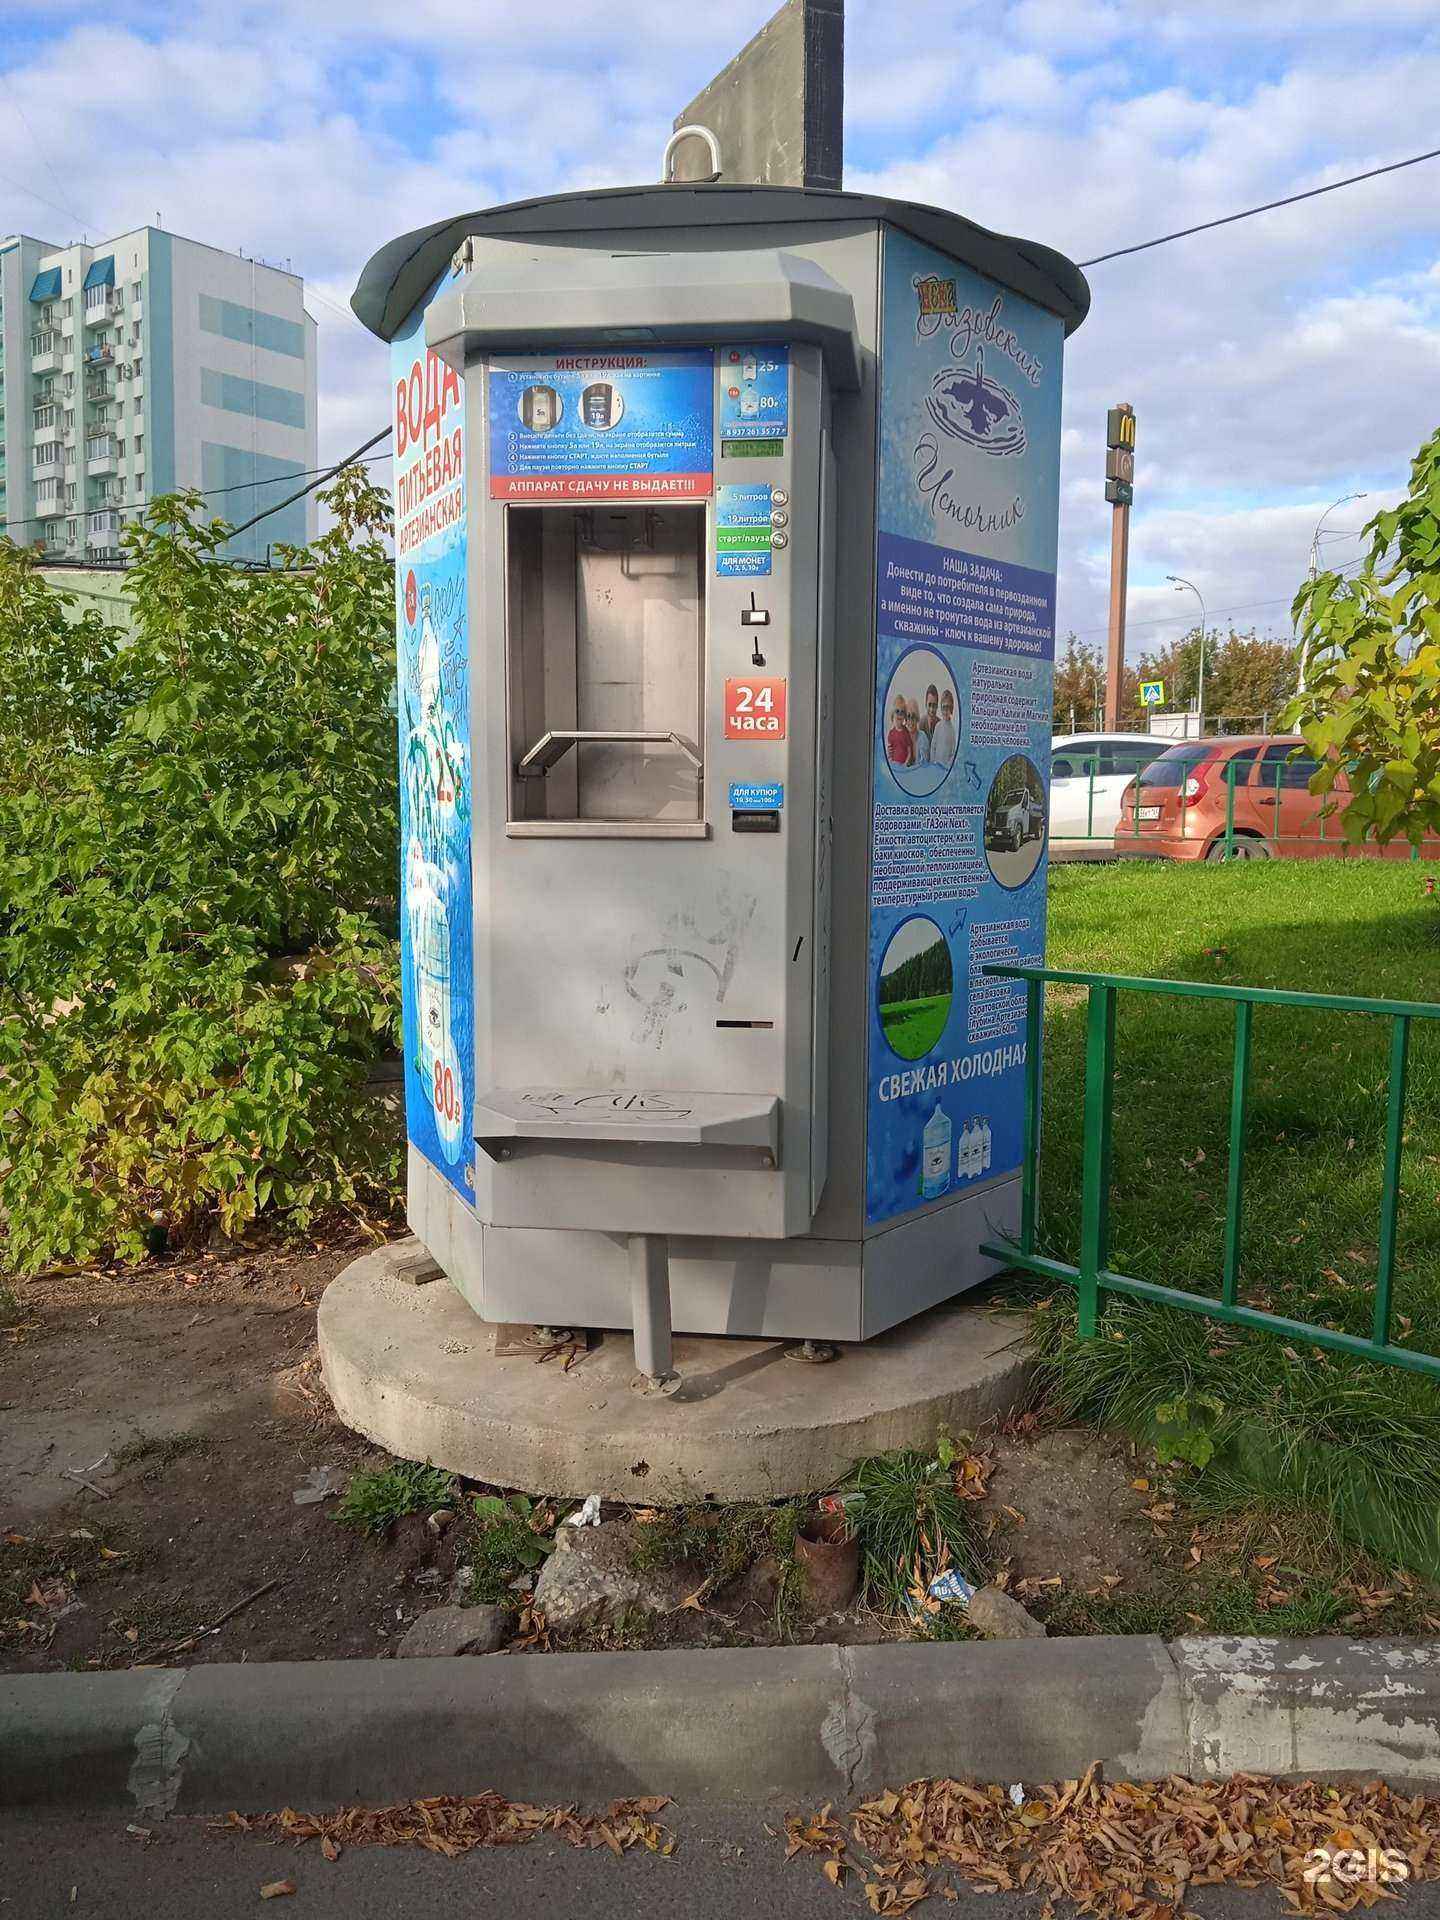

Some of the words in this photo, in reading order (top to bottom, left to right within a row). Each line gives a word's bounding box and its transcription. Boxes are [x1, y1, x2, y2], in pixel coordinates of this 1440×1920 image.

[556, 356, 647, 370] ИНСТРУКЦИЯ:
[397, 348, 460, 457] ВОДА
[398, 427, 461, 519] ПИТЬЕВАЯ
[629, 461, 649, 469] СТАРТ
[509, 480, 566, 493] АППАРАТ
[568, 480, 610, 494] СДАЧУ
[613, 480, 630, 491] НЕ
[632, 479, 696, 493] ВЫДАЕТ!!!
[740, 493, 768, 502] литров
[398, 486, 461, 555] АРТЕЗИАНСКАЯ
[738, 515, 768, 524] литров
[718, 533, 770, 543] старт/пауза
[721, 556, 739, 567] ДЛЯ
[739, 556, 766, 565] МОНЕТ
[943, 556, 969, 575] НАША
[969, 563, 1003, 583] ЗАДАЧА:
[886, 561, 924, 583] Донести
[924, 573, 936, 587] до
[937, 576, 989, 601] потребителя
[989, 587, 995, 597] в
[995, 586, 1048, 609] первозданном
[900, 585, 922, 601] виде
[923, 590, 936, 604] то,
[937, 593, 952, 605] что
[952, 595, 984, 612] создала
[985, 602, 1004, 615] сама
[1004, 606, 1038, 624] природа,
[881, 599, 887, 610] а
[888, 600, 922, 617] именно
[923, 607, 934, 618] не
[935, 609, 973, 626] тронутая
[974, 616, 993, 630] вода
[994, 620, 1003, 631] из
[1003, 622, 1052, 639] артезианской
[894, 619, 939, 637] скважины
[944, 627, 966, 642] ключ
[973, 632, 1004, 650] вашему
[971, 661, 1017, 677] Артезианская
[1017, 670, 1033, 681] вода
[735, 686, 774, 713] 24
[729, 715, 779, 731] часа
[733, 788, 750, 797] ДЛЯ
[750, 788, 777, 797] КУПЮР
[875, 804, 909, 817] Доставка
[910, 806, 930, 817] воды
[930, 805, 985, 817] осуществляется
[874, 820, 922, 832] водовозами
[874, 833, 906, 845] Емкости
[874, 847, 893, 861] баки
[928, 846, 976, 858] обеспеченны
[873, 862, 925, 877] необходимой
[873, 876, 941, 892] поддерживающей
[941, 870, 990, 885] естественный
[873, 891, 933, 906] температурный
[933, 888, 957, 902] режим
[969, 922, 1014, 937] Артезианская
[1014, 918, 1031, 929] вода
[878, 1062, 947, 1102] СВЕЖАЯ
